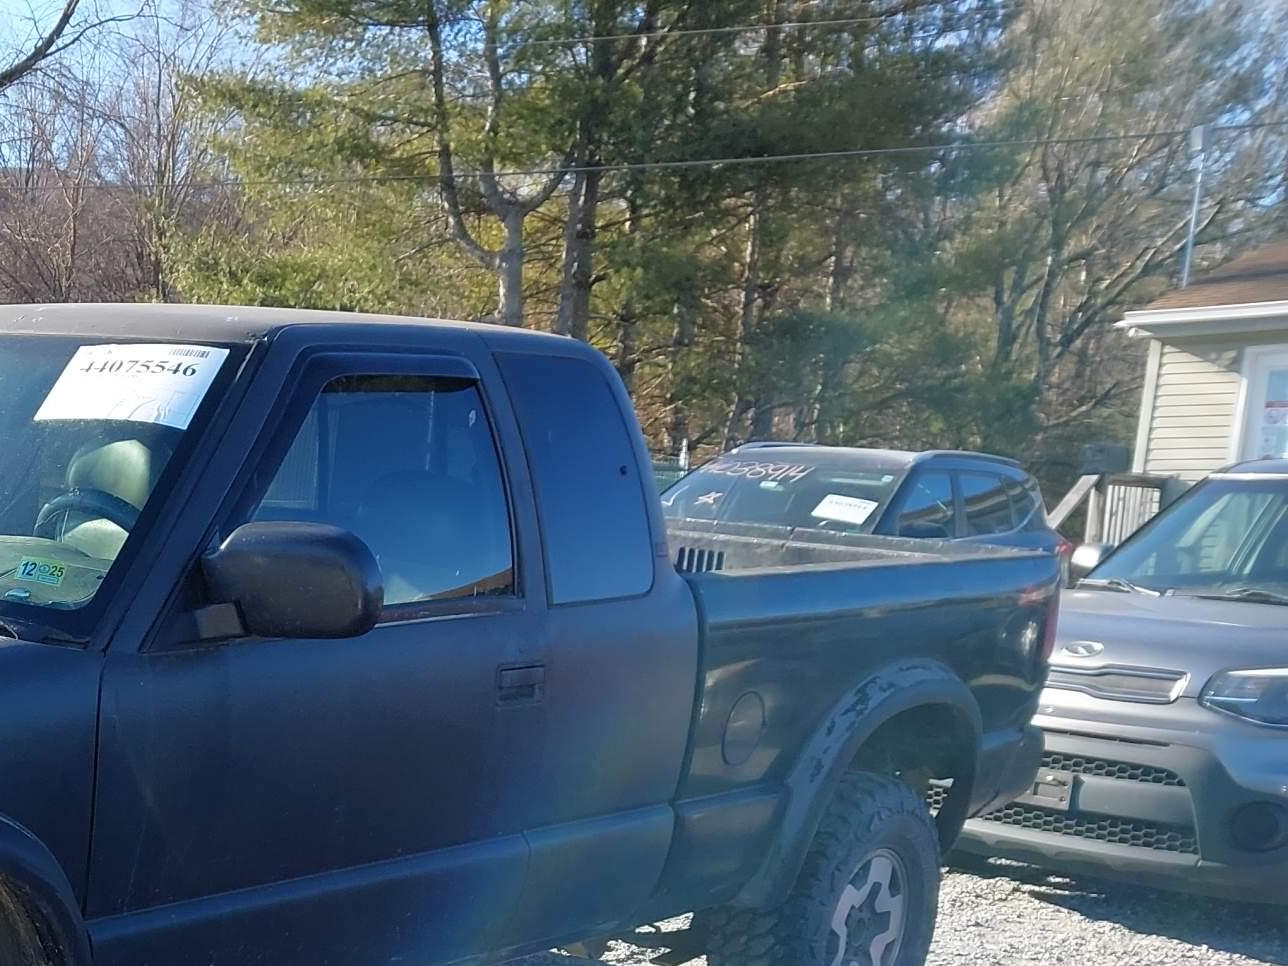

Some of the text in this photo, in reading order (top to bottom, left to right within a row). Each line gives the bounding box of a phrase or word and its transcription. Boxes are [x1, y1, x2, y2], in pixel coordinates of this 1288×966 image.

[80, 359, 201, 377] 44075546
[22, 561, 65, 578] 12 25
